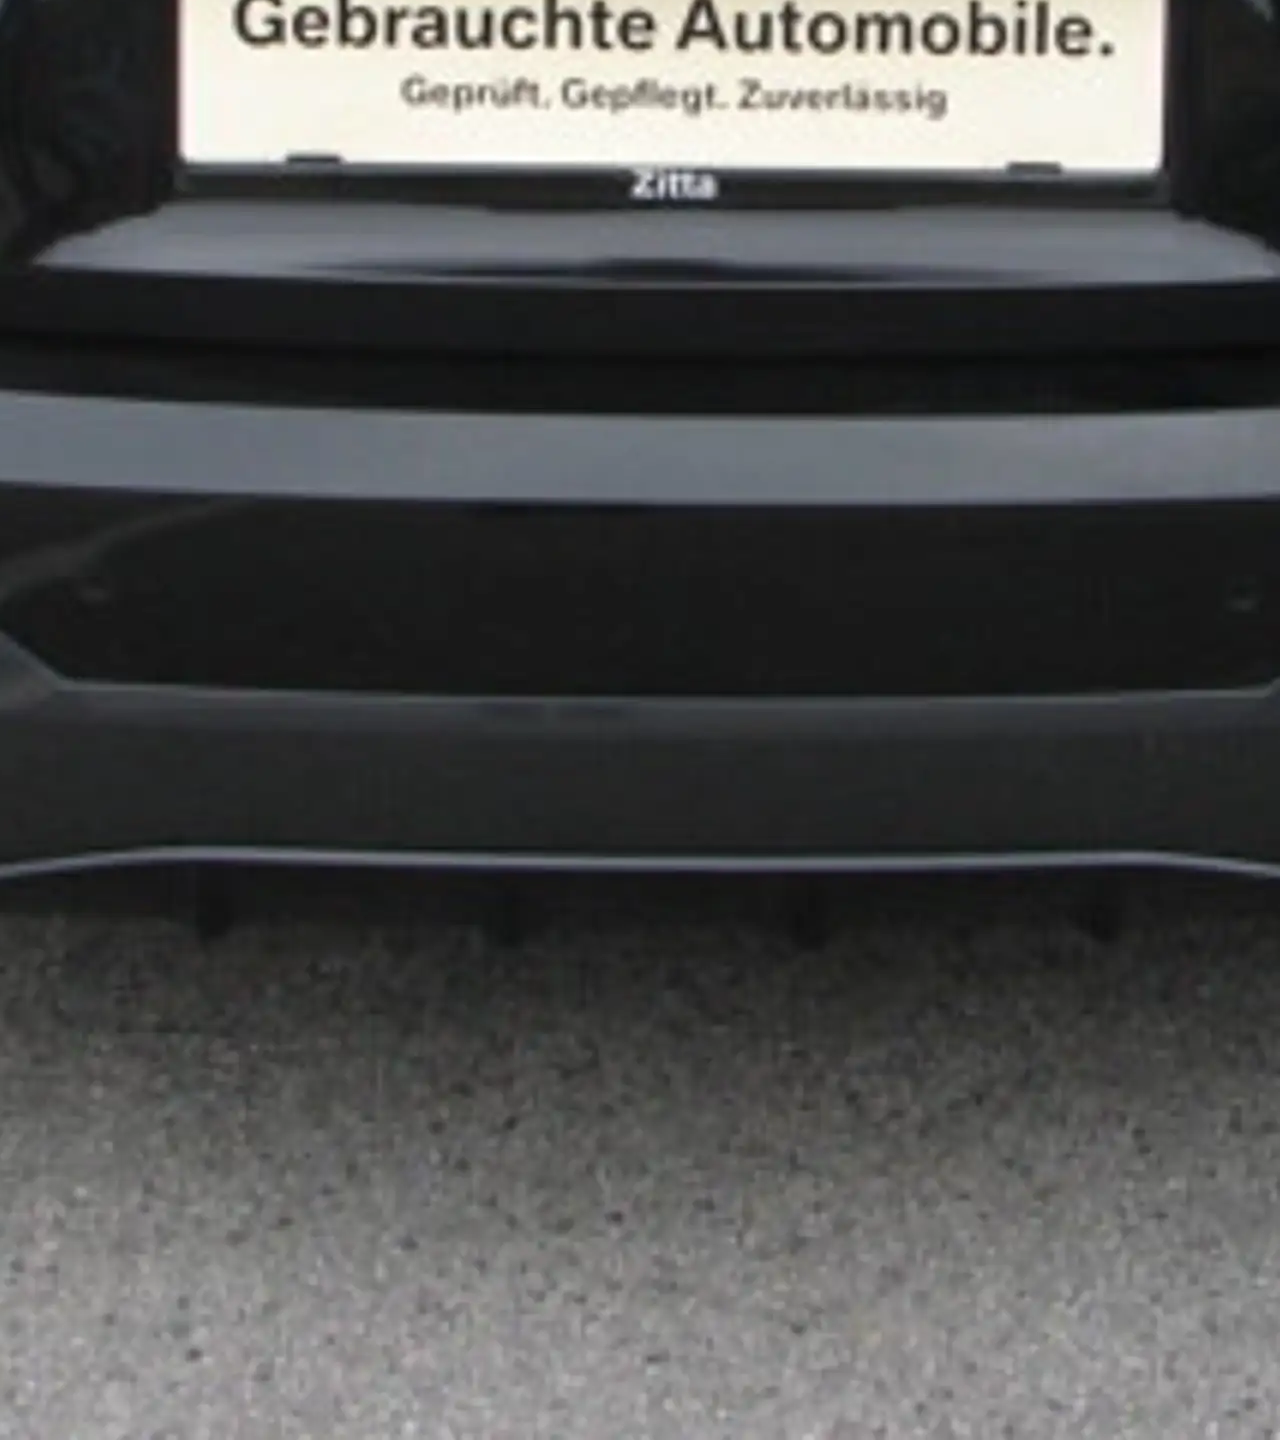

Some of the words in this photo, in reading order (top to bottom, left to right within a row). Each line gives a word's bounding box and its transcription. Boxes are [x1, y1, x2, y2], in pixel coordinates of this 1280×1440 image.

[400, 76, 549, 112] Geprüft.
[560, 78, 728, 117] Gepflegt.
[630, 166, 718, 200] Zitta
